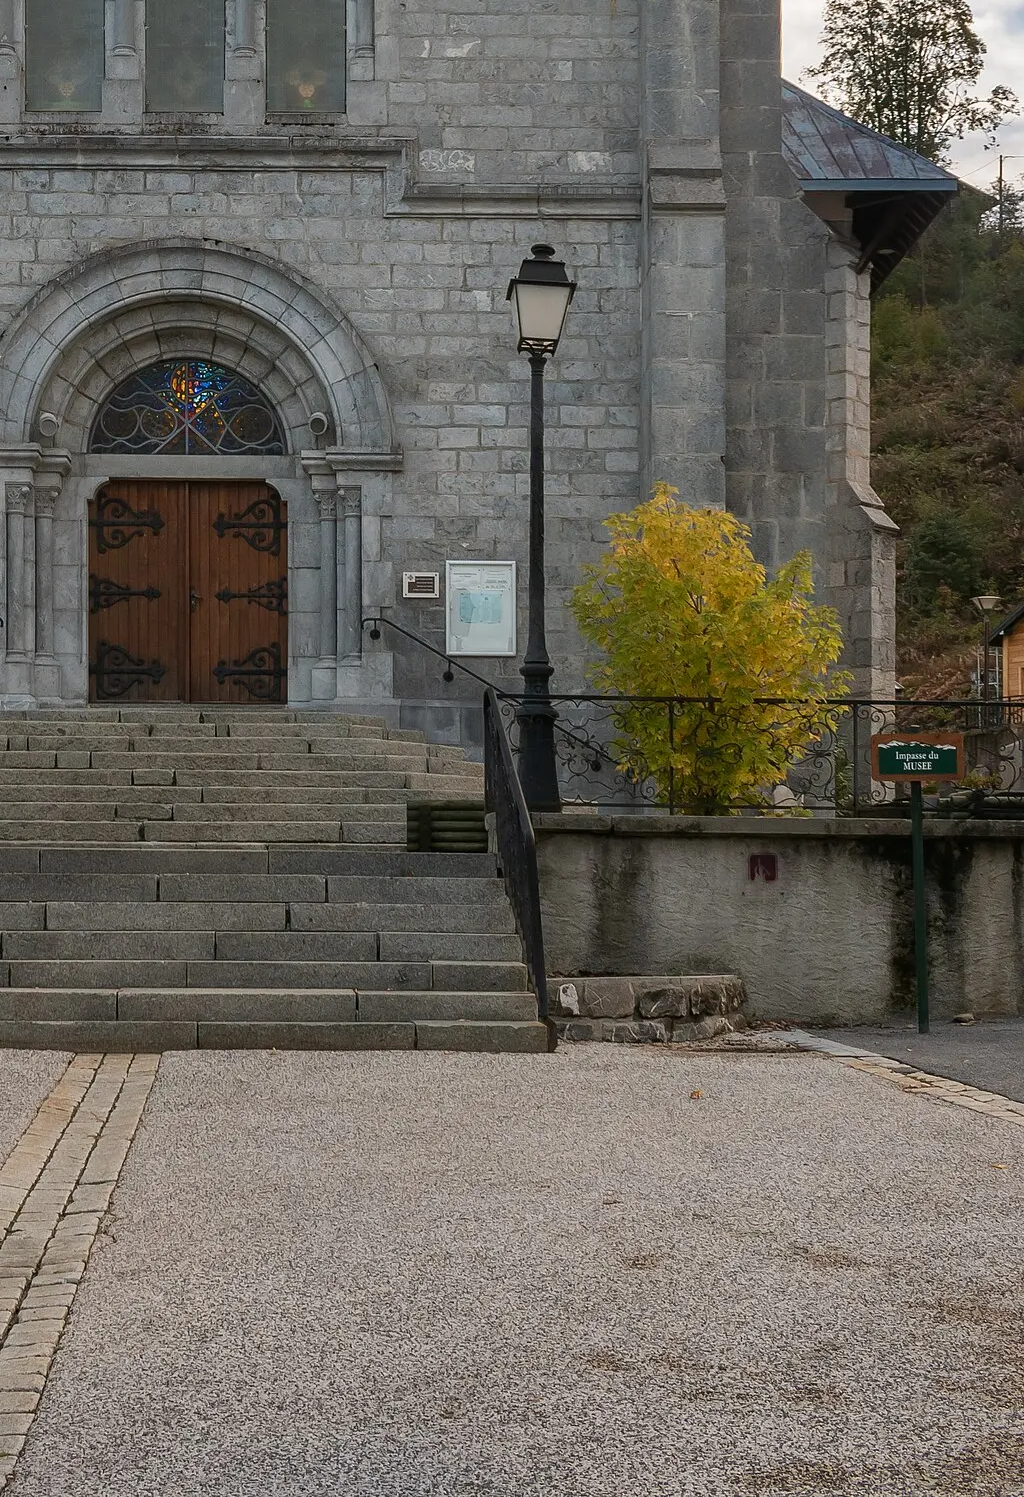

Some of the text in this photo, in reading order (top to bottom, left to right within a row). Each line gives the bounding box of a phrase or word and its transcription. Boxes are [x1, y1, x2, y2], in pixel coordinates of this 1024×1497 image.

[895, 751, 939, 761] Impasse du
[903, 762, 933, 770] MUSEE
